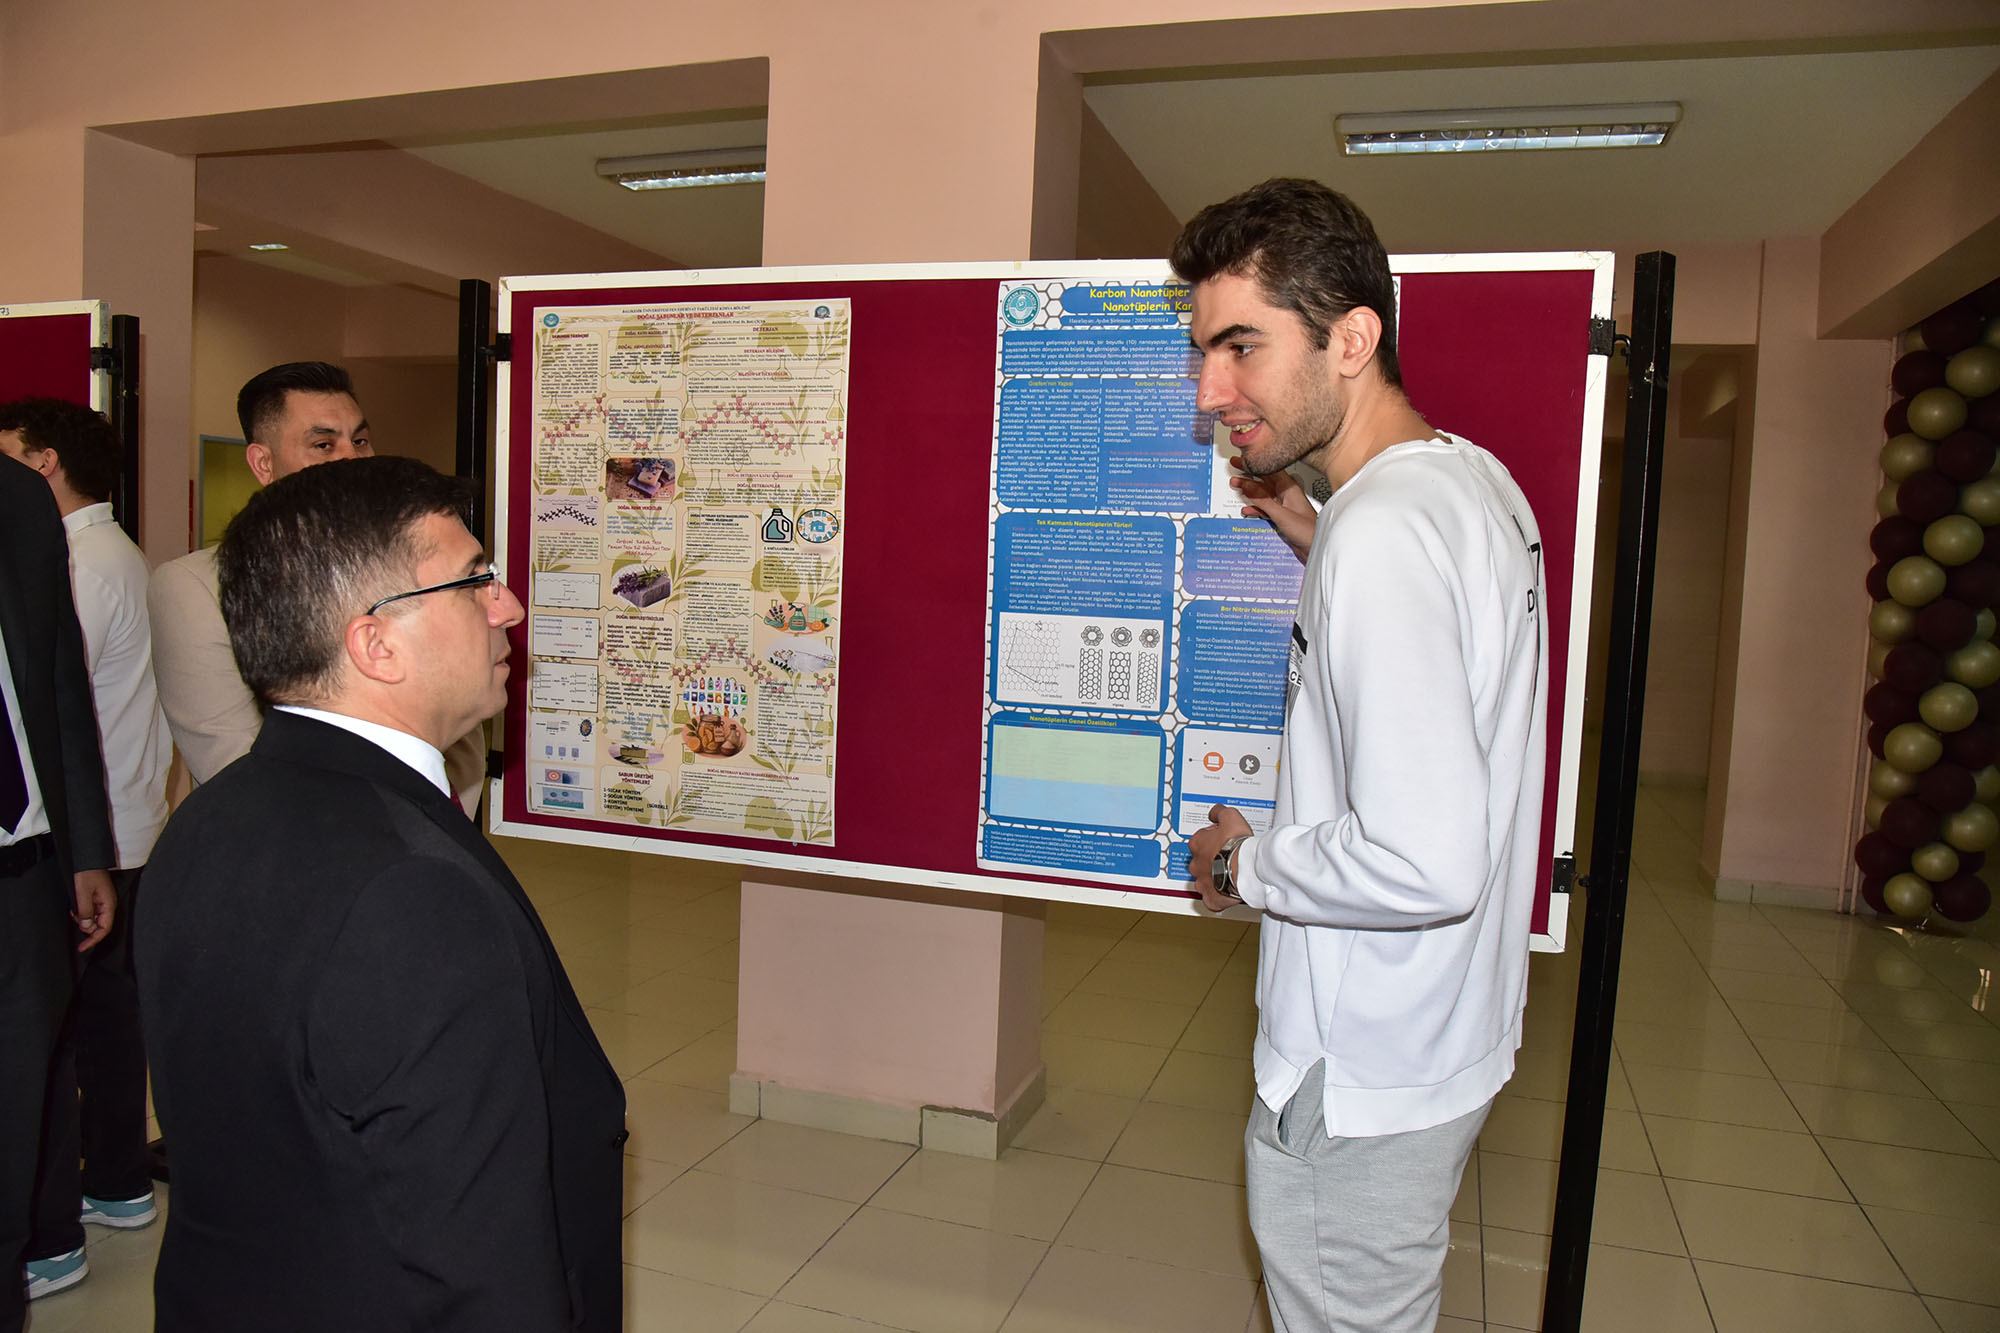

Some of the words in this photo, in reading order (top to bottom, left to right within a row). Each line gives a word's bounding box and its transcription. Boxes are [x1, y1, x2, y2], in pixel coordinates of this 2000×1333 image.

[1090, 288, 1126, 298] Karbon
[1131, 288, 1190, 300] Nanotüpler
[1103, 302, 1170, 313] Nanotüplerin
